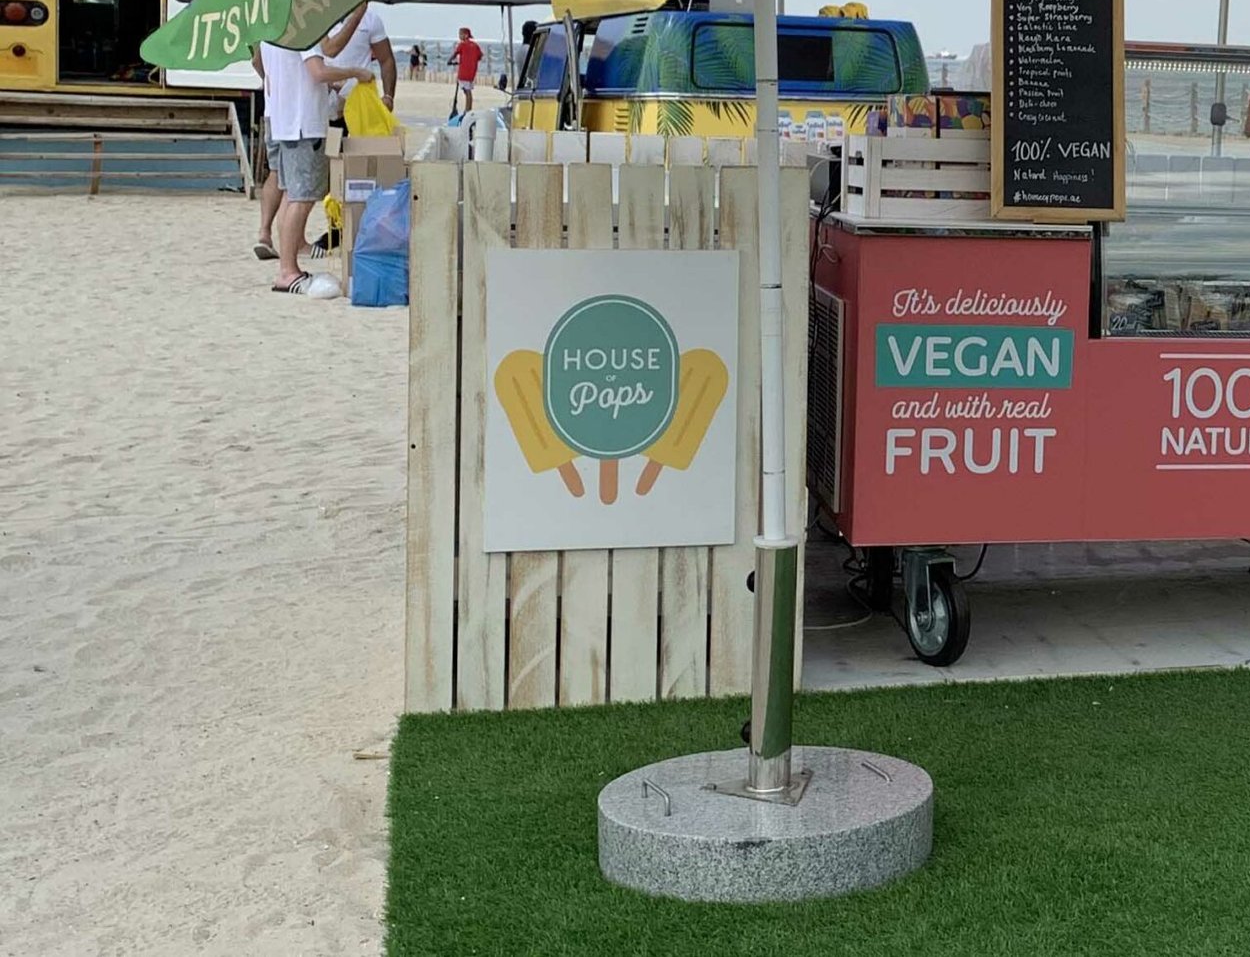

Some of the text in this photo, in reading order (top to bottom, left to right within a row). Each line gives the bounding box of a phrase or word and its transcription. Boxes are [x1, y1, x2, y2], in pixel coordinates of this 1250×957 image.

[187, 1, 242, 61] IT'S
[1016, 13, 1093, 24] Super Strawberry
[1011, 137, 1111, 161] 100% VEGAN
[892, 288, 1067, 326] It's deliciously
[563, 348, 661, 370] HOUSE
[887, 335, 1060, 377] VEGAN
[605, 374, 617, 382] OF
[569, 381, 653, 419] Pops
[892, 393, 1052, 419] and with real
[885, 428, 1057, 475] FRUIT
